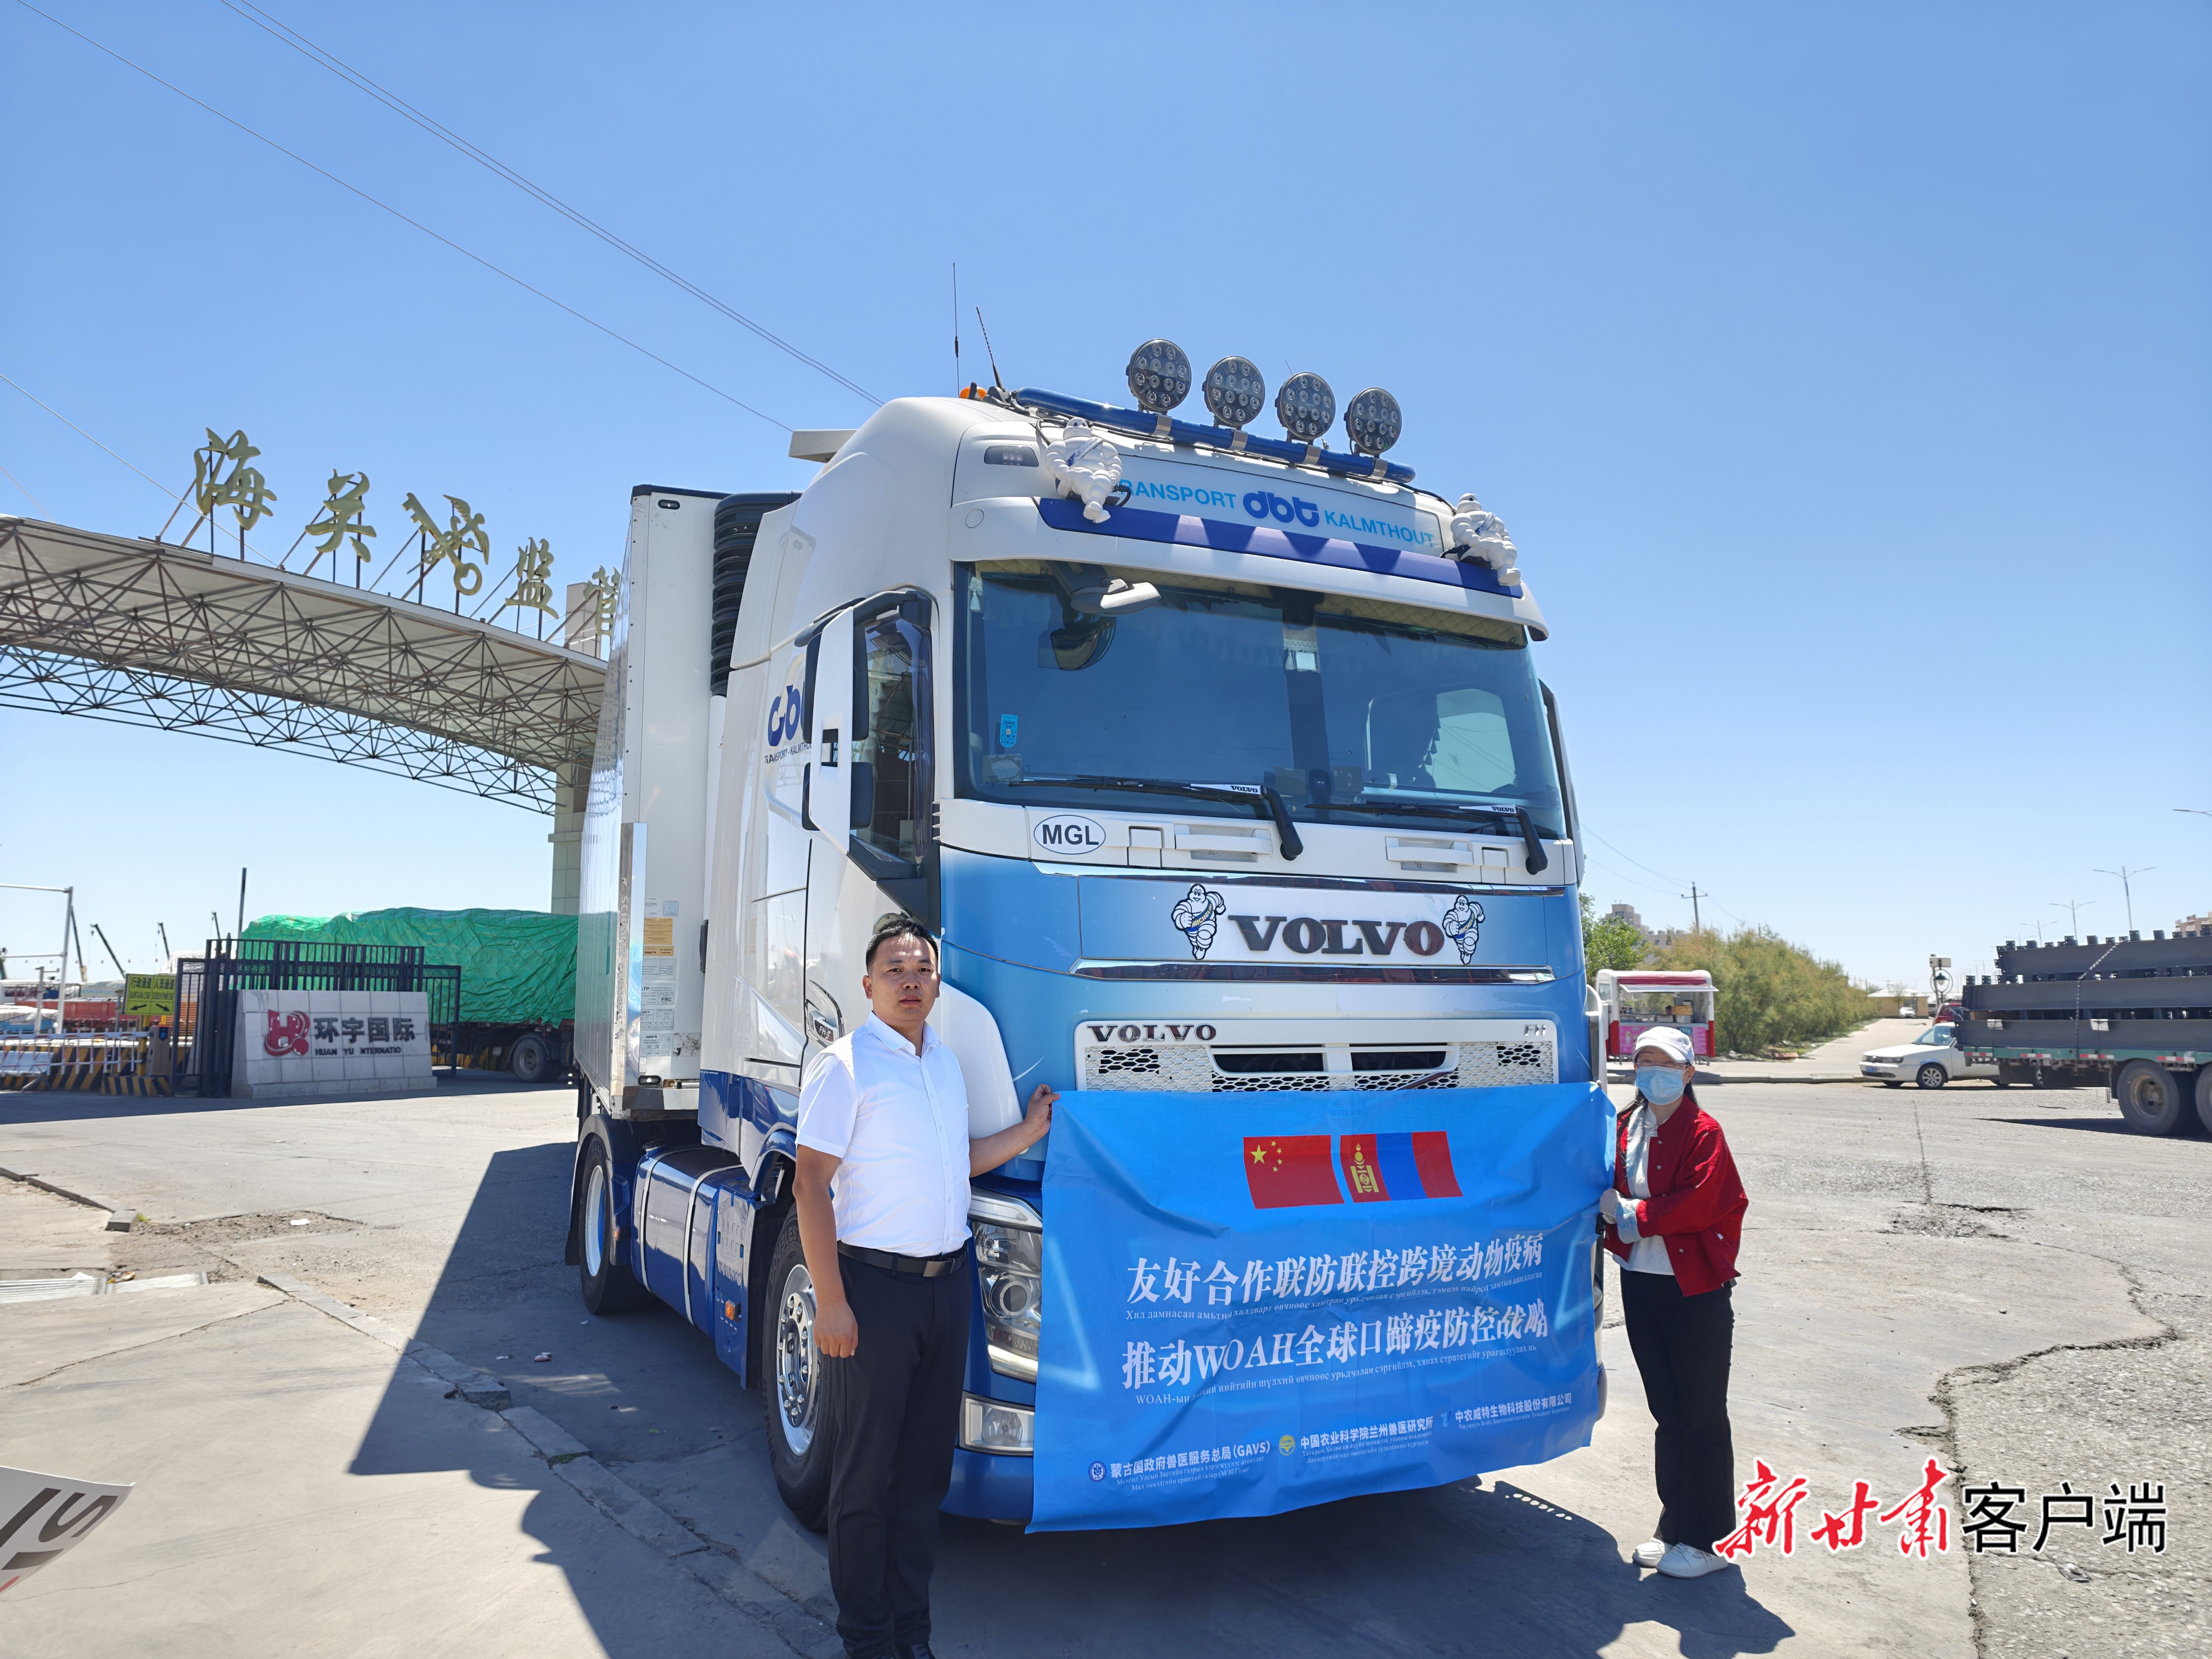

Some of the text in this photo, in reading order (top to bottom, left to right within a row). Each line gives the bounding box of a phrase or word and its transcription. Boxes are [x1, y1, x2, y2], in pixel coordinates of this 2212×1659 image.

[194, 427, 377, 562] 海关
[1117, 479, 1236, 509] RANSPORT
[1243, 490, 1320, 528] dbt
[1324, 510, 1434, 548] KALMTHOUT
[1042, 824, 1100, 845] MGL
[618, 895, 629, 957] SCHMITZ
[1192, 903, 1213, 928] MICHELIN
[1228, 915, 1445, 956] VOLVO
[314, 1017, 415, 1043] 环宇国际
[1087, 1024, 1217, 1043] VOLVO
[1524, 1024, 1546, 1036] FH
[1127, 1233, 1544, 1305] 友好合作联防联控跨境动物疫病
[1126, 1310, 1145, 1320] Хил
[1147, 1310, 1195, 1319] дамнасан
[1197, 1311, 1232, 1320] амьтны
[1233, 1305, 1273, 1317] халдварт
[1274, 1301, 1310, 1311] өвчнөөс
[1311, 1297, 1344, 1309] хамтран
[1344, 1292, 1388, 1305] урьдчилан
[1389, 1289, 1431, 1299] сэргийлэх,
[1432, 1286, 1459, 1294] тэмцэх
[1490, 1279, 1512, 1291] хамтын
[1122, 1298, 1548, 1389] 推动WOAH全球口蹄疫防控战略
[1136, 1393, 1190, 1405] WOAH-ын
[1218, 1380, 1257, 1392] нийтийн
[1259, 1375, 1294, 1388] шүлхий
[1296, 1372, 1330, 1383] өвчнөөс
[1331, 1367, 1373, 1381] урьдчилан
[1375, 1360, 1415, 1373] сэргийлэх,
[1417, 1357, 1439, 1367] хянах
[1440, 1350, 1480, 1364] стратегийг
[1455, 1393, 1572, 1423] 中农威特生物科技股份有限公司
[1300, 1416, 1433, 1449] 中国农业科学院兰州兽医研究所
[1110, 1441, 1270, 1479] 蒙古国政府兽医服务总局(GAVS)
[1116, 1476, 1138, 1486] Монгол
